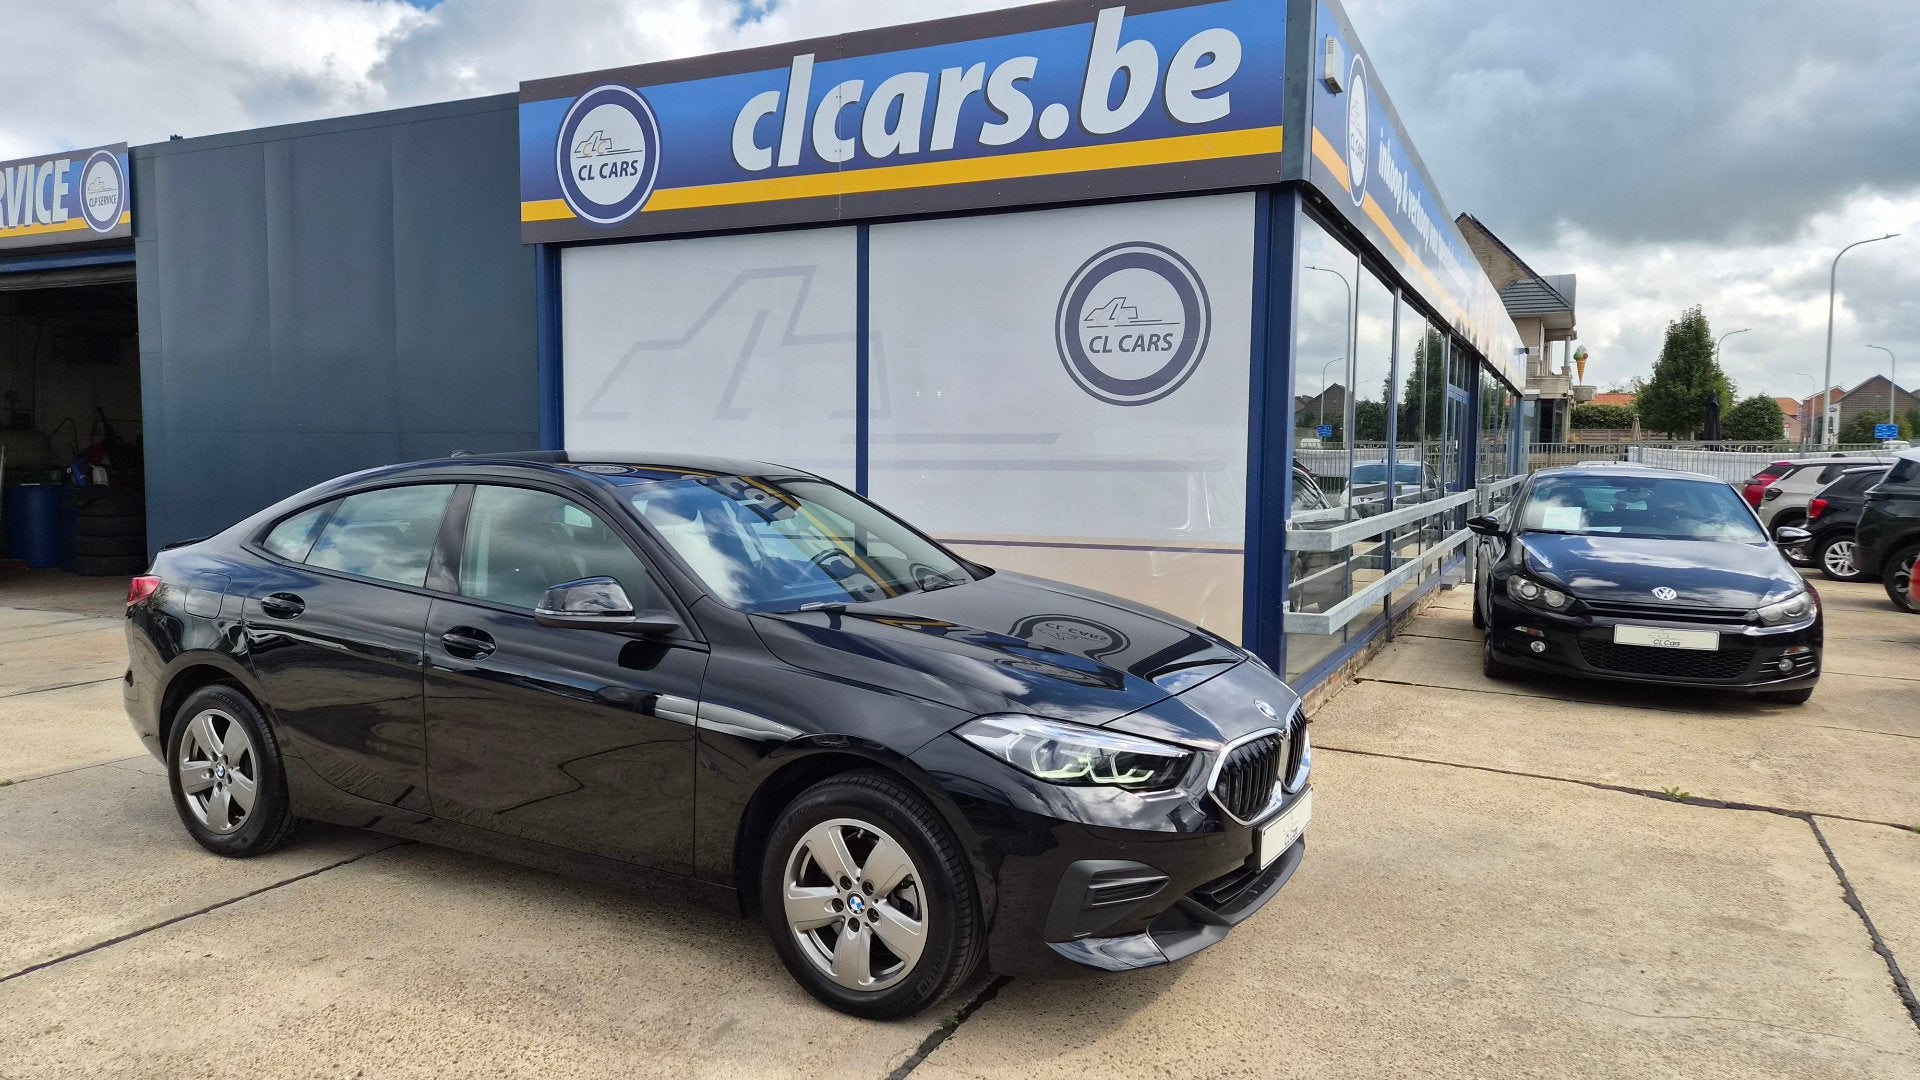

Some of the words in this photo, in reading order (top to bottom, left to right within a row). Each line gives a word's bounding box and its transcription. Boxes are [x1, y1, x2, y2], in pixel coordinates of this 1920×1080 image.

[731, 6, 1242, 171] clcars.be
[578, 164, 595, 181] CL
[599, 159, 639, 179] CARS
[98, 194, 117, 206] SERVICE
[1089, 335, 1112, 354] CL
[1118, 332, 1174, 352] CARS
